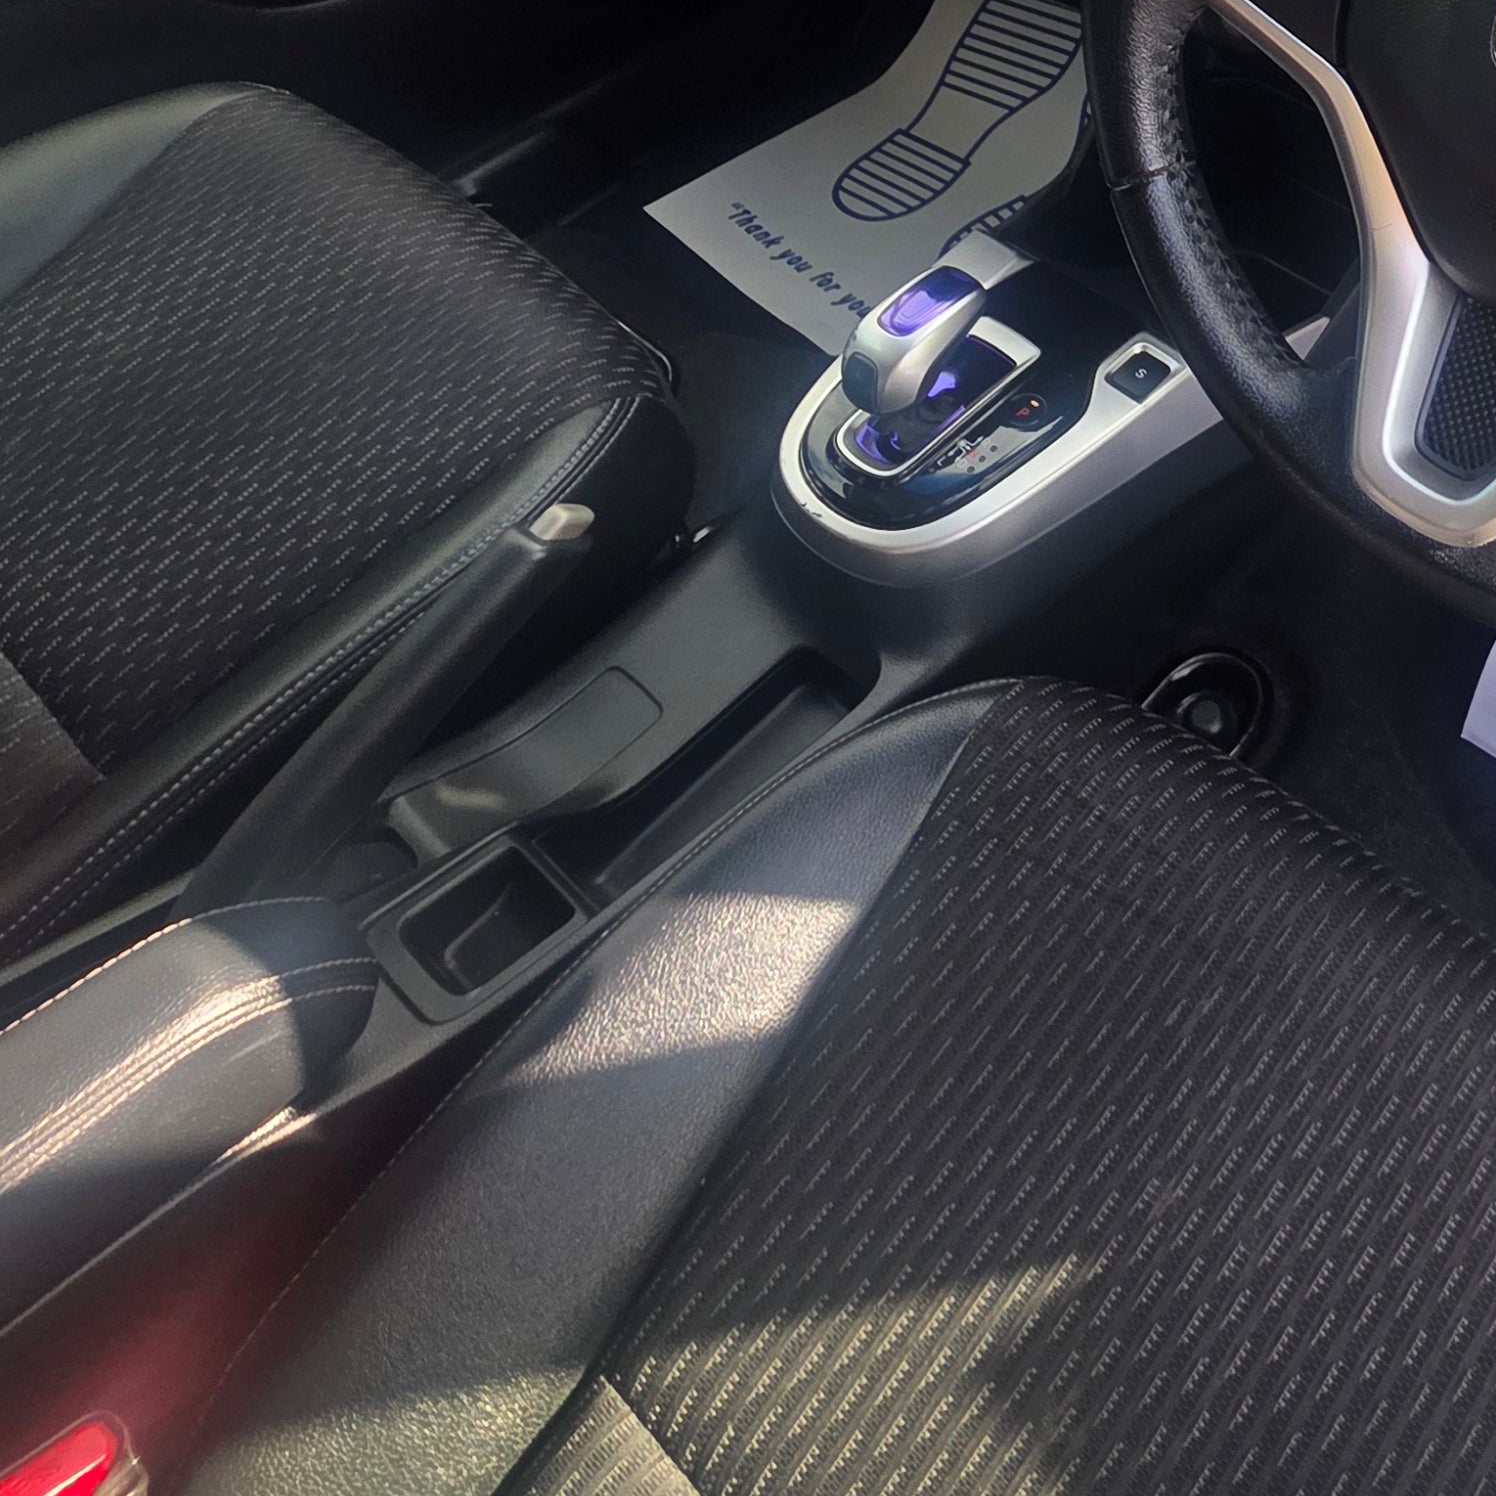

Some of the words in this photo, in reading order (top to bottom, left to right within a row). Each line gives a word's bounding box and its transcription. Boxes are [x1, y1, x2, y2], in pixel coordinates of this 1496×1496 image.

[769, 248, 813, 273] you
[809, 271, 841, 292] for
[830, 292, 873, 319] you
[1135, 367, 1147, 379] S
